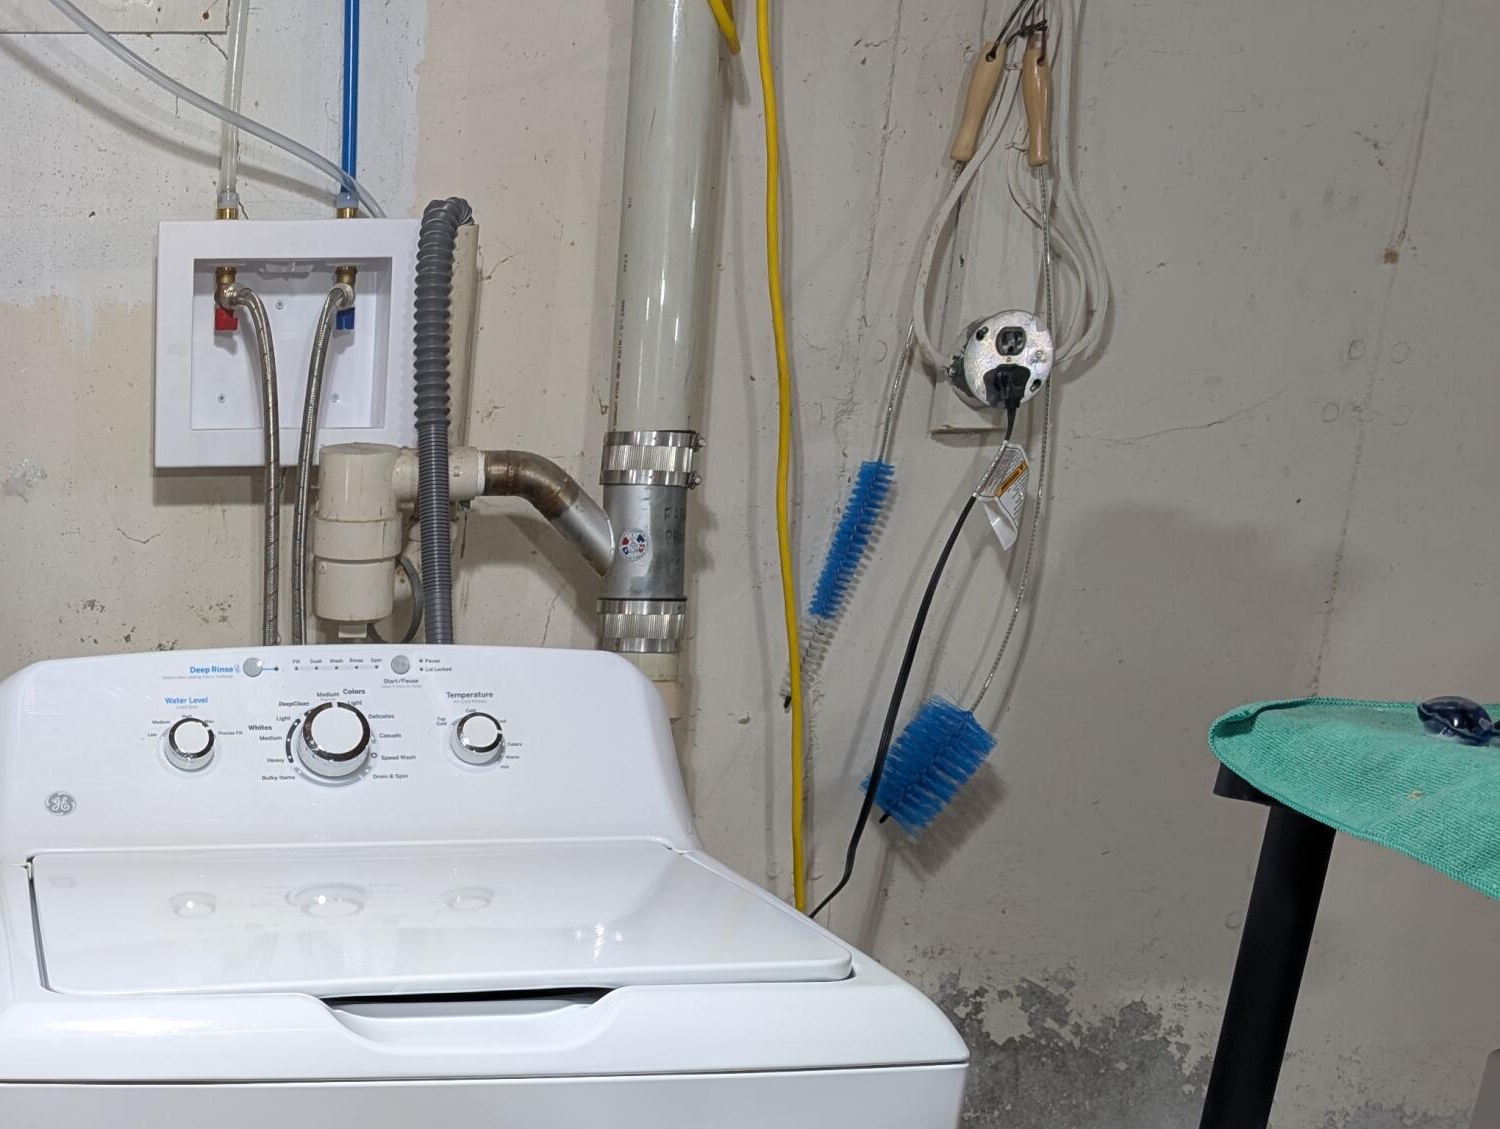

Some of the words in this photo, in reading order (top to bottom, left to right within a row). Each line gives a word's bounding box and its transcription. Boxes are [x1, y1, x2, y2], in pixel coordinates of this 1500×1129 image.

[189, 666, 210, 675] Deep
[211, 665, 233, 674] Rinse
[445, 691, 494, 699] Temperature
[189, 696, 208, 704] Level
